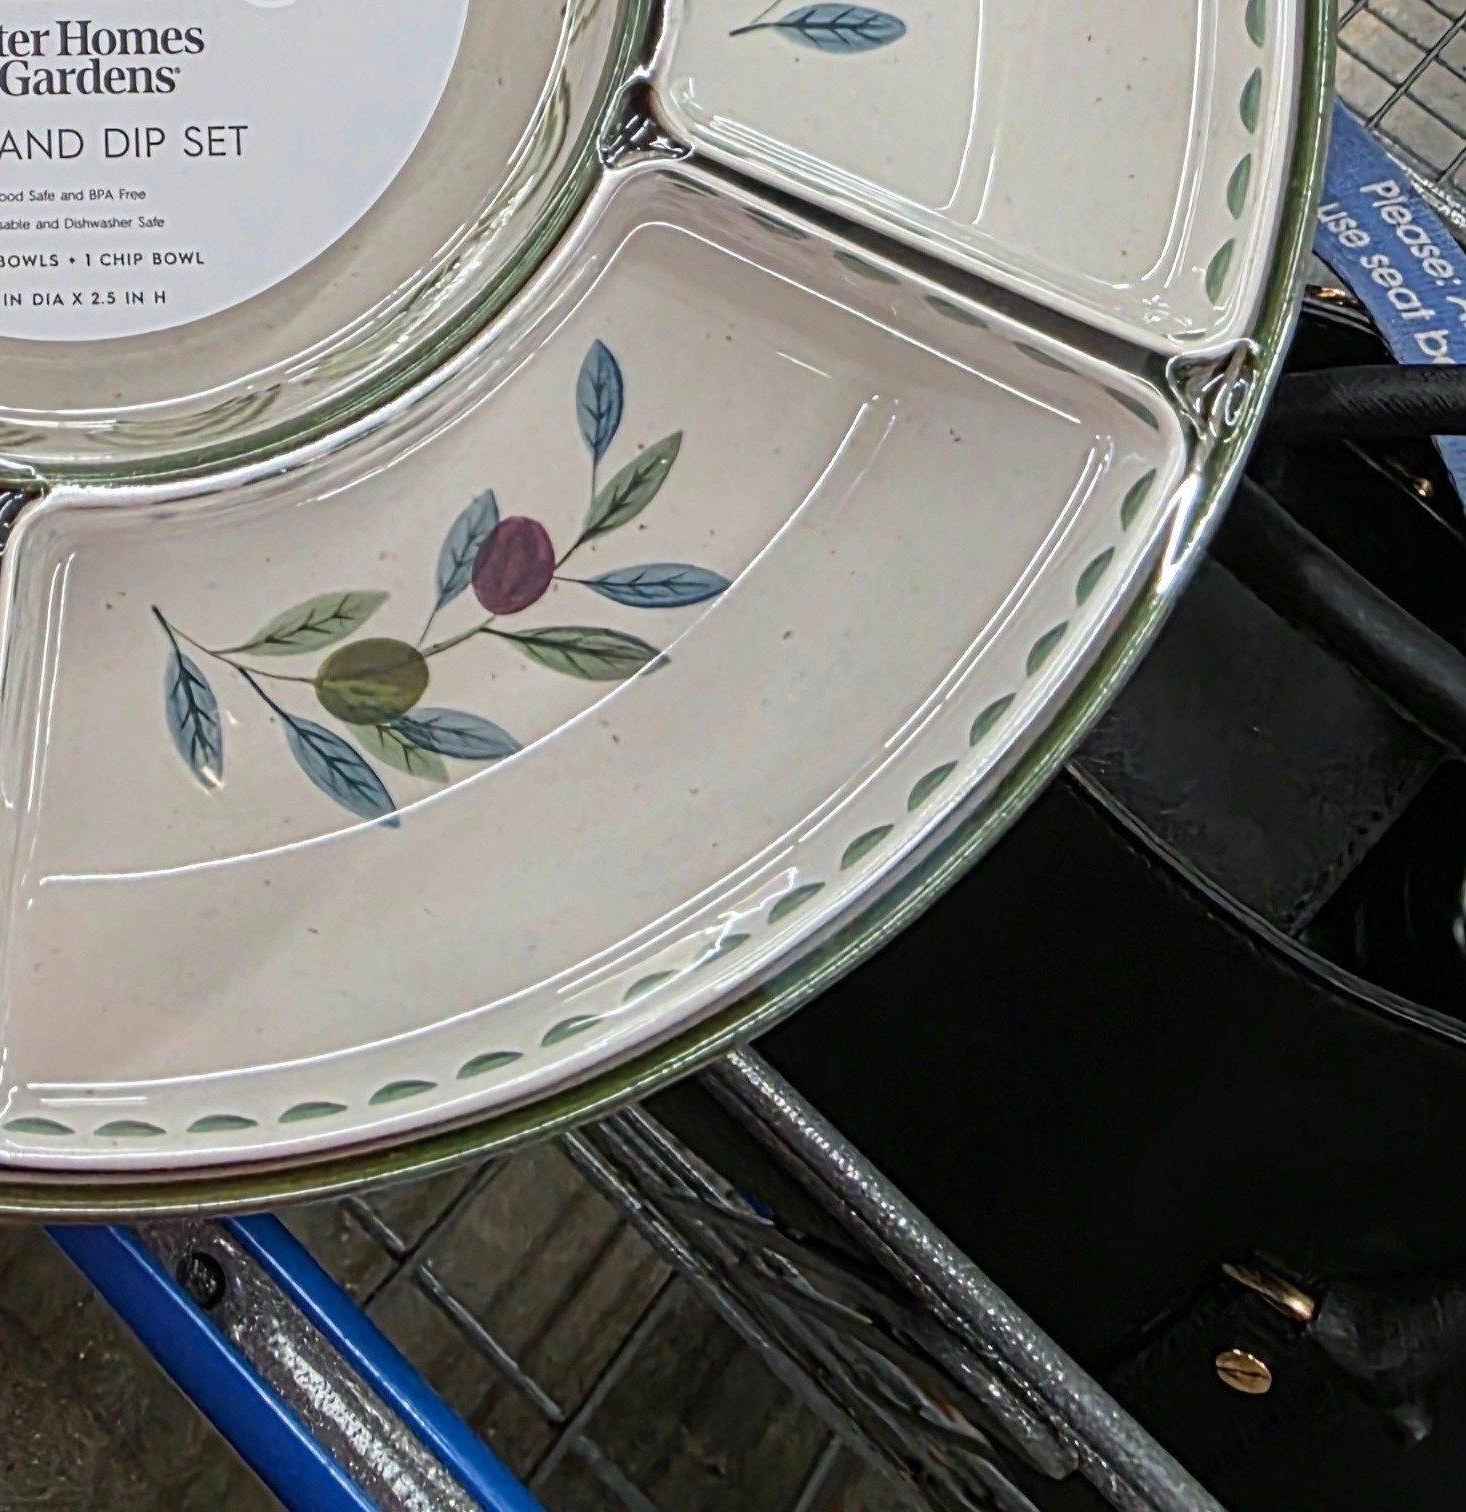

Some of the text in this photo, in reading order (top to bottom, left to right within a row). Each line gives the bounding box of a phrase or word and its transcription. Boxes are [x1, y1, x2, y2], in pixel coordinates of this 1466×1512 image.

[55, 19, 205, 57] Homes
[104, 126, 166, 159] DIP
[183, 125, 249, 157] SET
[29, 190, 55, 202] Safe
[60, 190, 84, 201] and
[88, 189, 114, 201] BPA
[118, 189, 146, 200] Free
[36, 217, 60, 230] and
[64, 216, 134, 230] Dishwasher
[138, 215, 165, 228] Safe
[1359, 179, 1461, 286] Please:
[85, 253, 92, 267] 1
[99, 252, 144, 267] CHIP
[152, 251, 205, 266] BOWL
[1316, 202, 1370, 247] use
[1359, 254, 1435, 320] seat
[3, 293, 22, 306] IN
[33, 292, 65, 306] DIA
[72, 292, 83, 305] X
[91, 291, 116, 305] 2.5
[126, 291, 144, 304] IN
[154, 290, 166, 304] H
